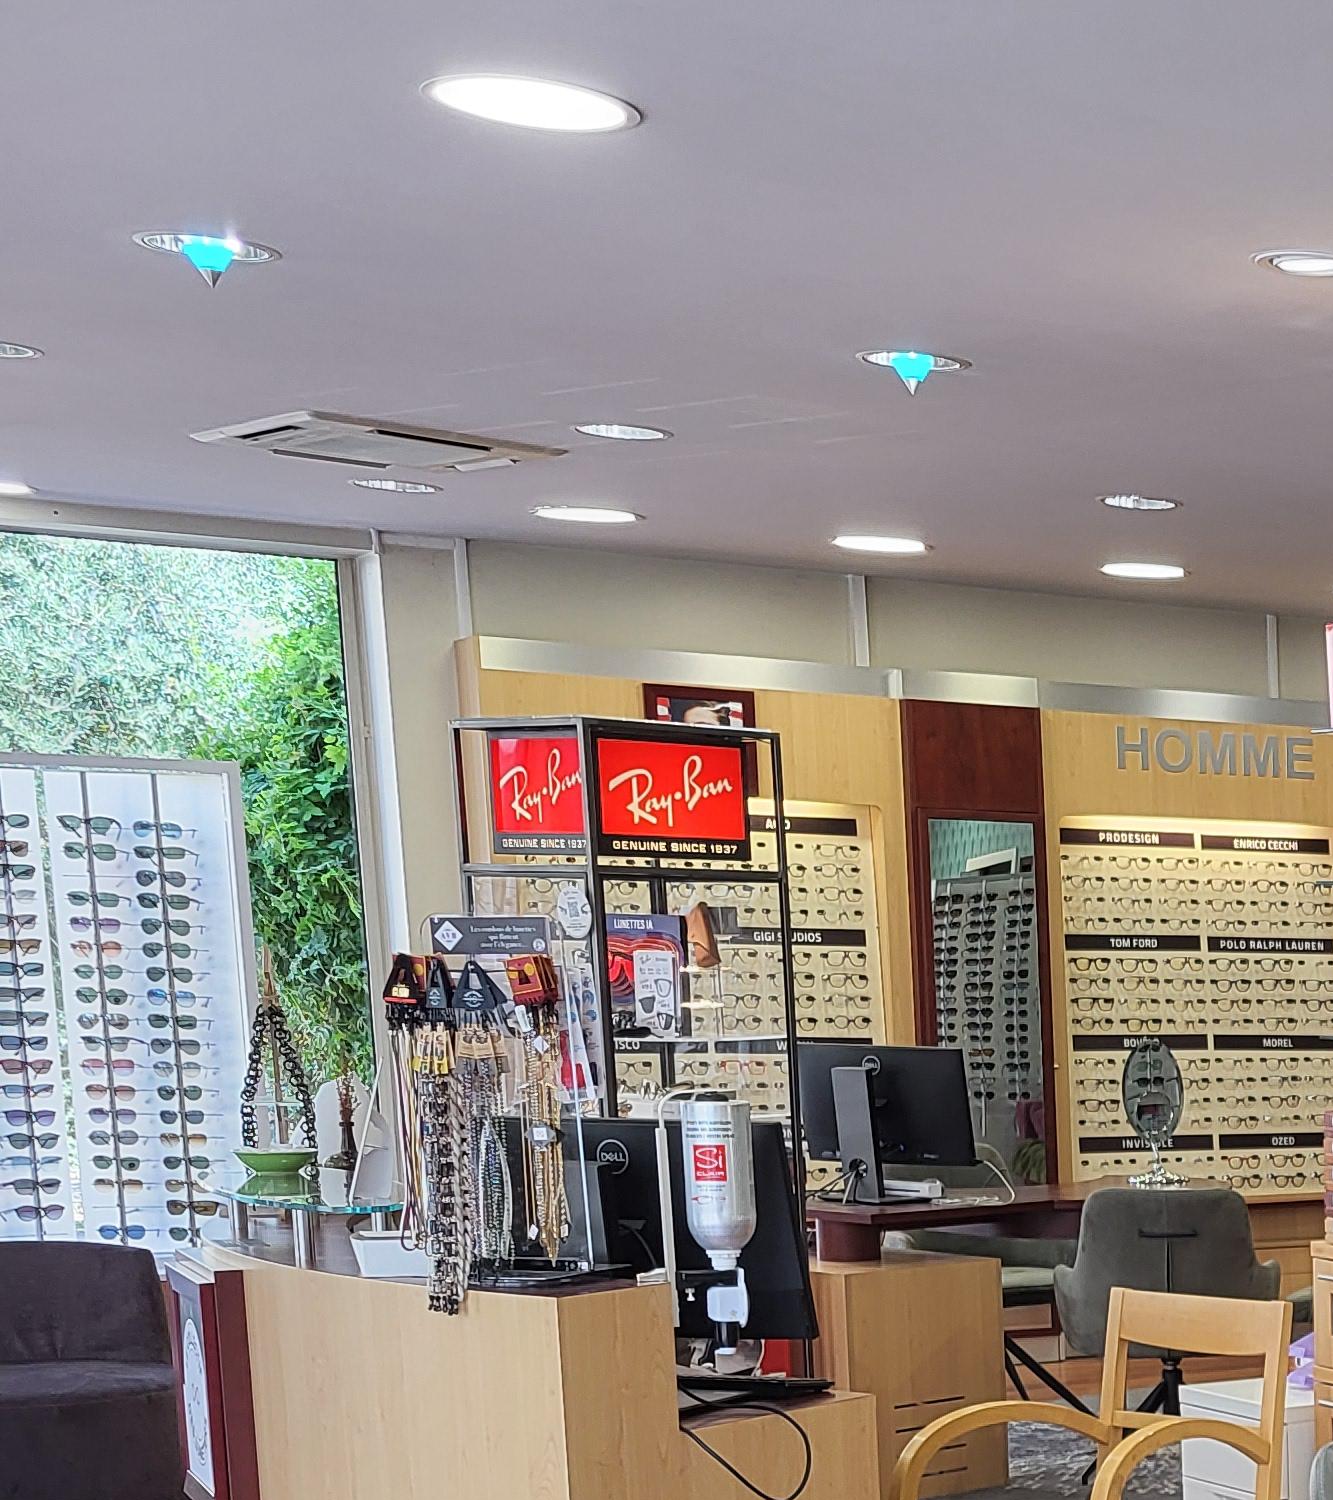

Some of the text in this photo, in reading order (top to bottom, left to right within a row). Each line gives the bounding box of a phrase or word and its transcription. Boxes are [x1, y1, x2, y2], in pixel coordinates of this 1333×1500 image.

[1116, 725, 1315, 780] HOMME
[502, 838, 539, 848] GENUINE
[541, 838, 565, 848] SINCE
[1099, 832, 1159, 844] PRODESIGN
[613, 840, 737, 854] GENUINE SINCE 1937
[1234, 839, 1298, 850] ENRICO CECCHI
[614, 919, 644, 929] LUNETTES
[753, 931, 822, 943] GIGI SUDIOS
[1110, 938, 1157, 948] TOM FORD
[1220, 939, 1324, 951] POLO RALPH LAUREN
[615, 1040, 640, 1050] ISCO
[1263, 1037, 1293, 1048] MOREL
[1122, 1138, 1174, 1149] INVISLE
[1272, 1137, 1295, 1146] OZED
[601, 1152, 626, 1162] DELL
